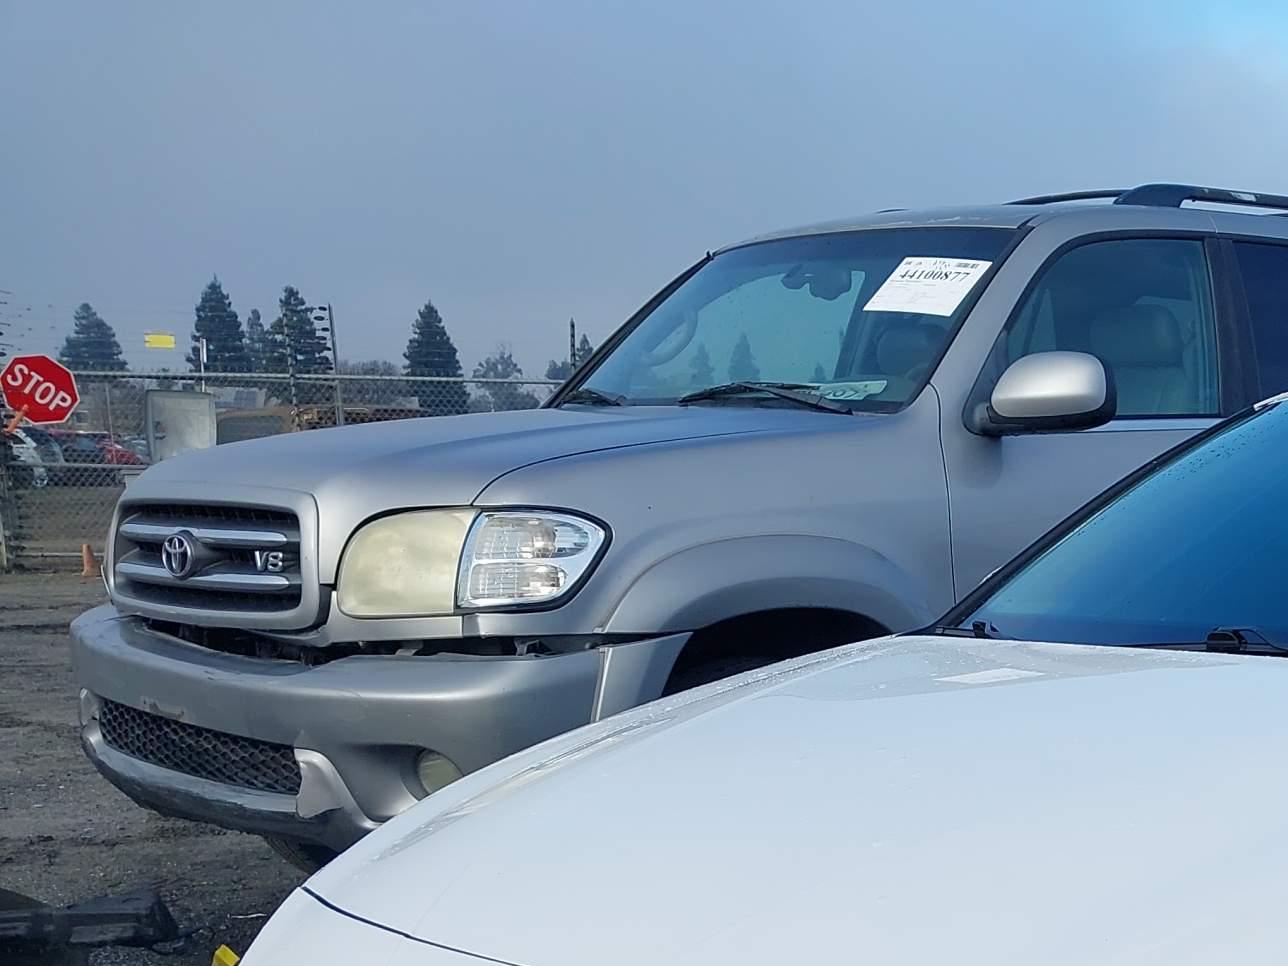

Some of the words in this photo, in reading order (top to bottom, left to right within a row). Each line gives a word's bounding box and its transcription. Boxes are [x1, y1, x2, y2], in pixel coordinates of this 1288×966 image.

[899, 269, 971, 282] 44100877
[6, 363, 73, 411] STOP
[254, 550, 284, 572] V8
